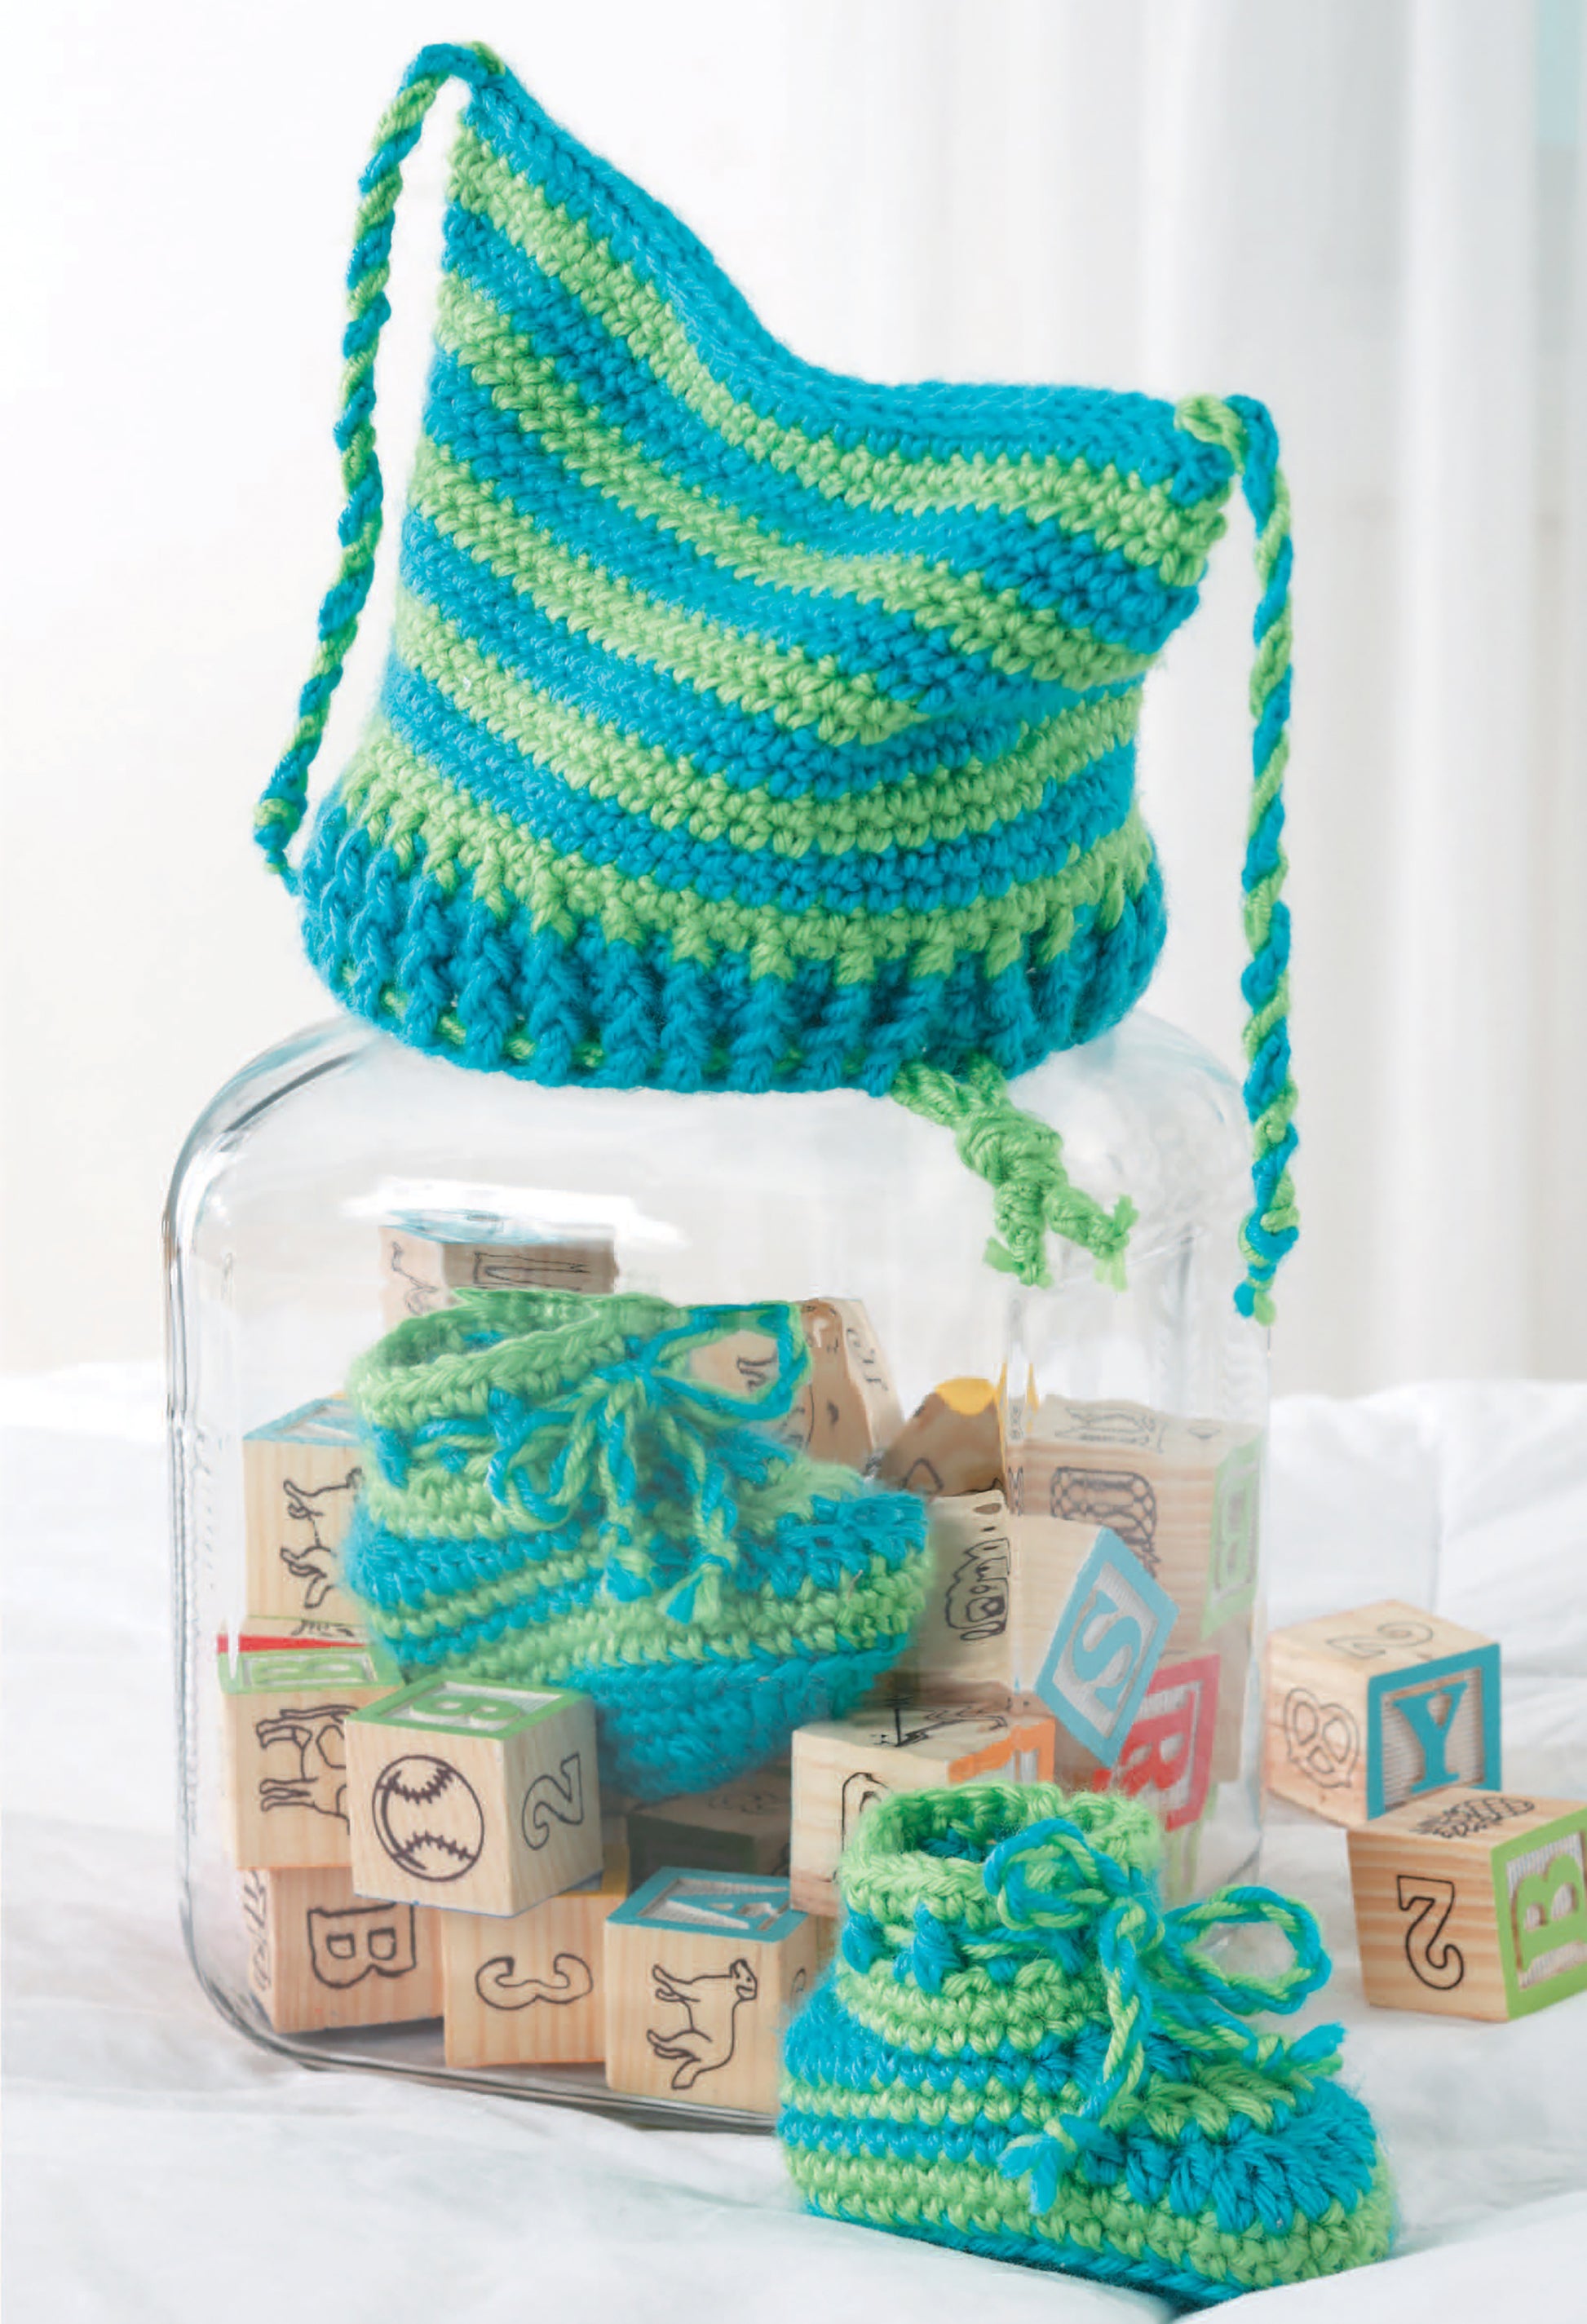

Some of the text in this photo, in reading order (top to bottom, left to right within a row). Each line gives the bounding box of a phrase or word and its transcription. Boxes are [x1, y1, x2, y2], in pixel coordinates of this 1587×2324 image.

[1072, 1589, 1143, 1712] S
[411, 1694, 520, 1721] B
[1120, 1689, 1196, 1798] R
[1393, 1681, 1468, 1794] Y
[521, 1751, 584, 1851] 2
[306, 1902, 417, 1990] B
[666, 1890, 790, 1932] A
[1397, 1875, 1465, 1990] 2
[1514, 1853, 1587, 1973] B
